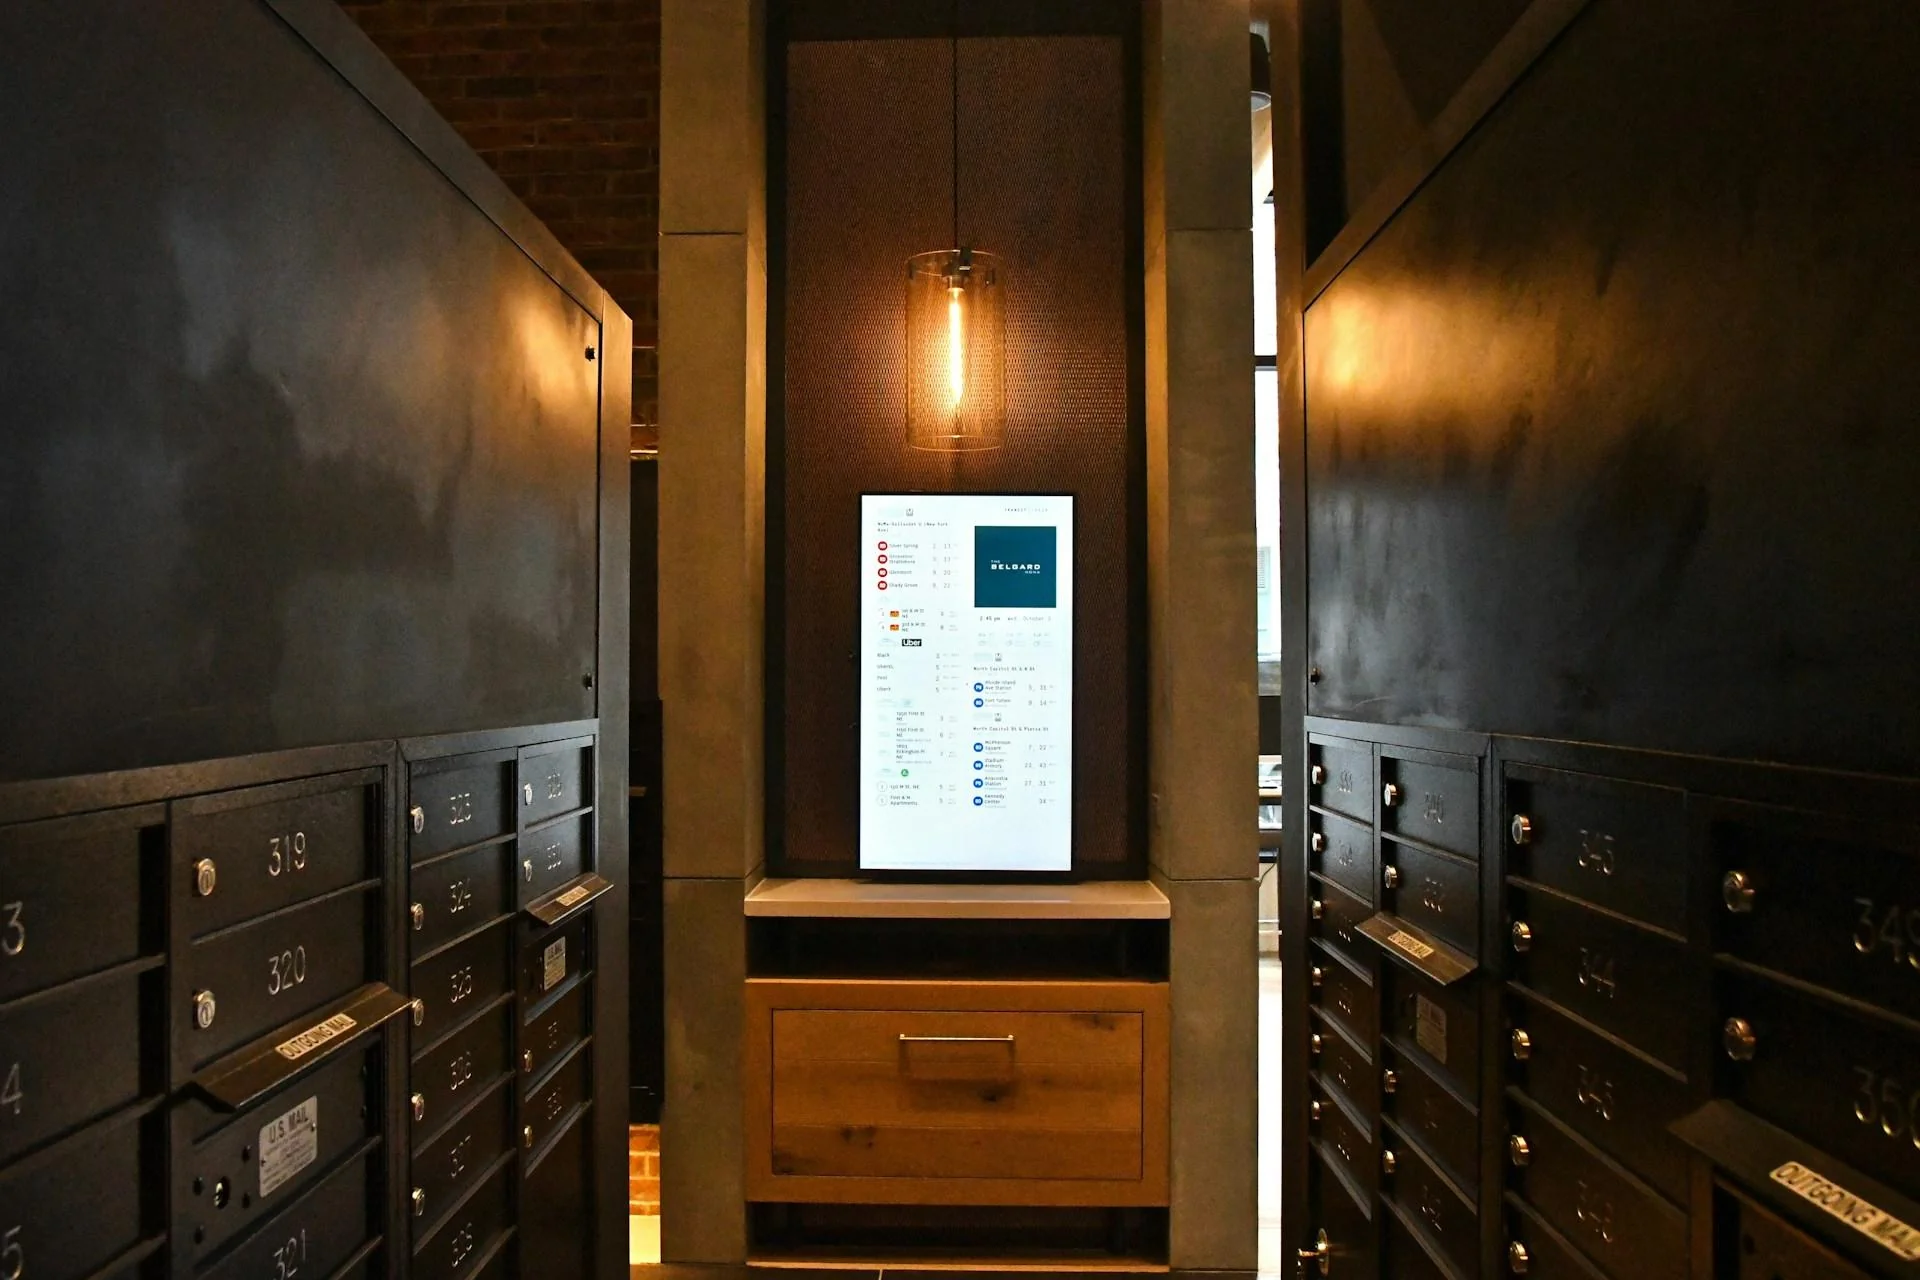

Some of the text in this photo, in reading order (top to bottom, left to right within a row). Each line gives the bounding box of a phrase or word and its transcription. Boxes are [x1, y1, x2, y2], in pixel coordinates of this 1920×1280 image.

[450, 792, 472, 825] 323
[268, 831, 306, 877] 319
[450, 877, 472, 914] 324
[268, 944, 306, 996] 320
[280, 1016, 354, 1057] OUTGOING MAIL
[288, 1106, 308, 1132] MAIL
[1776, 1164, 1877, 1225] OUTGOING
[272, 1228, 306, 1280] 321
